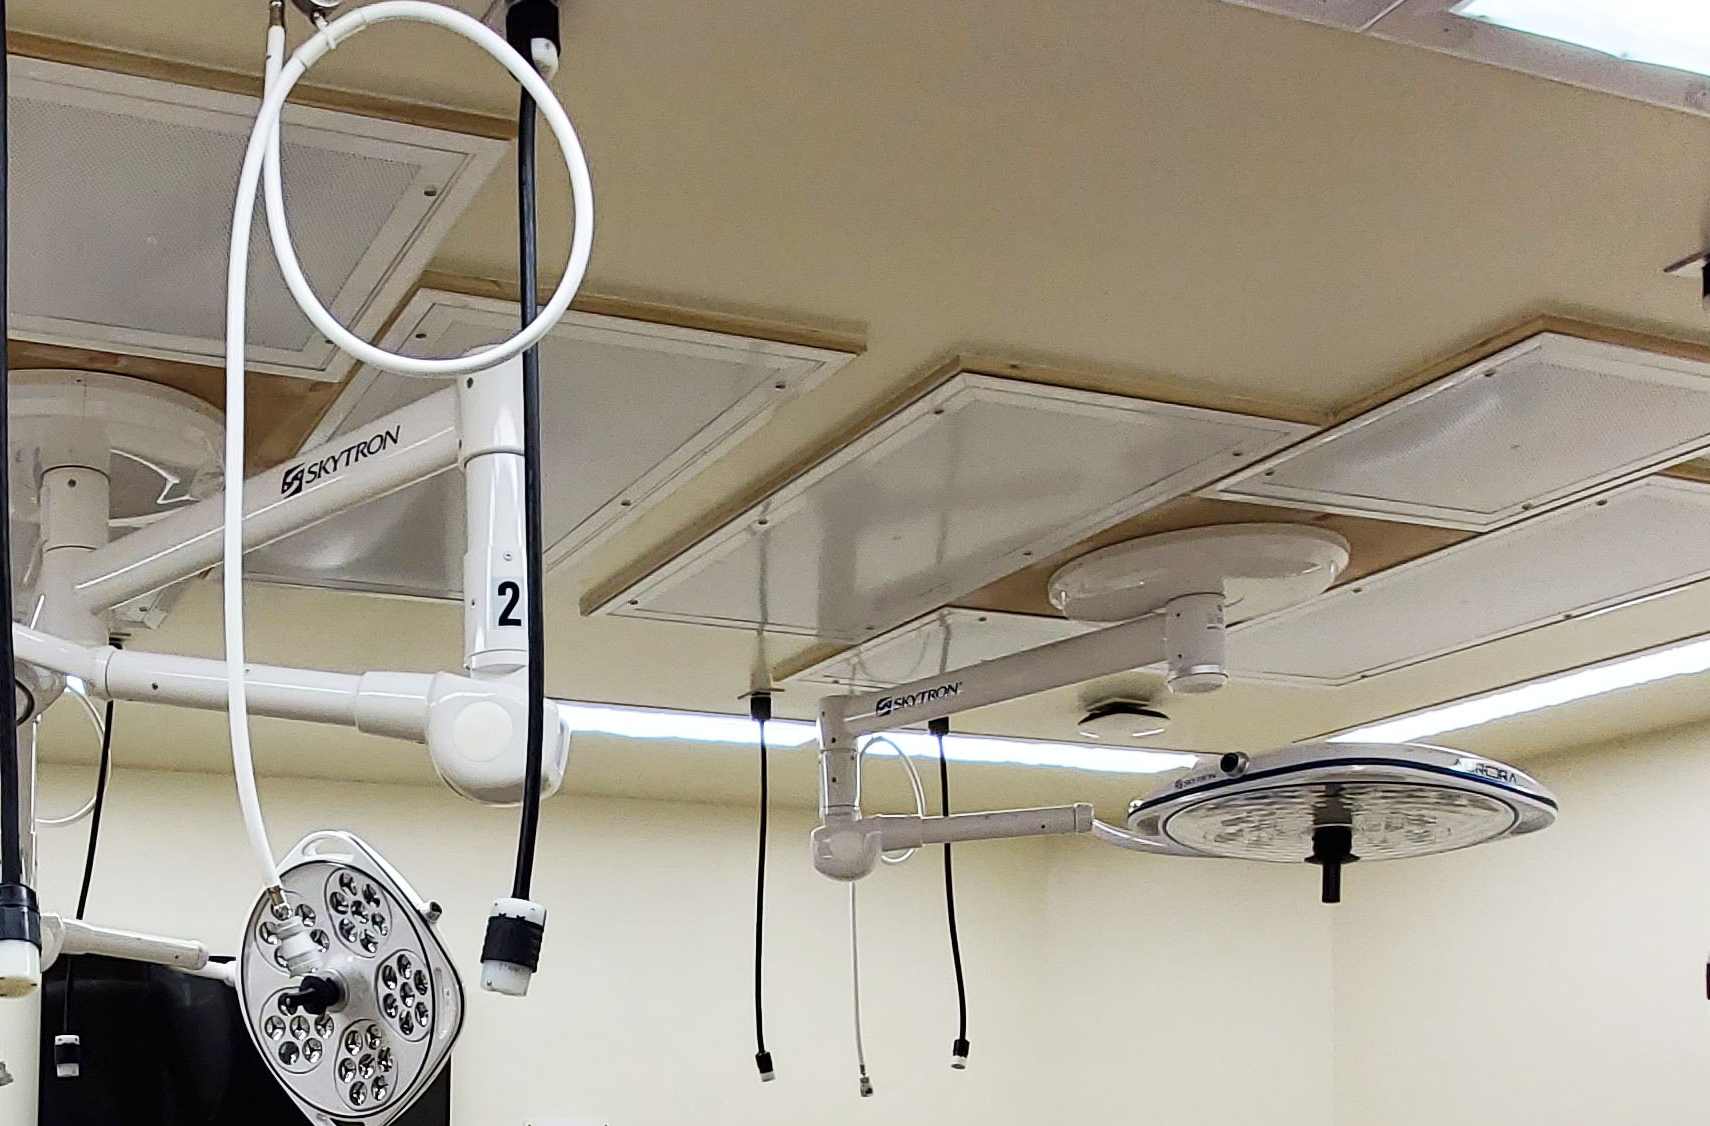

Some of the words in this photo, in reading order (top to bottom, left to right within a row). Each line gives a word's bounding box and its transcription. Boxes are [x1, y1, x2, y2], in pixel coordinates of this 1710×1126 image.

[305, 425, 401, 484] SKYTRON
[497, 581, 522, 627] 2
[893, 683, 959, 709] SKYTRON
